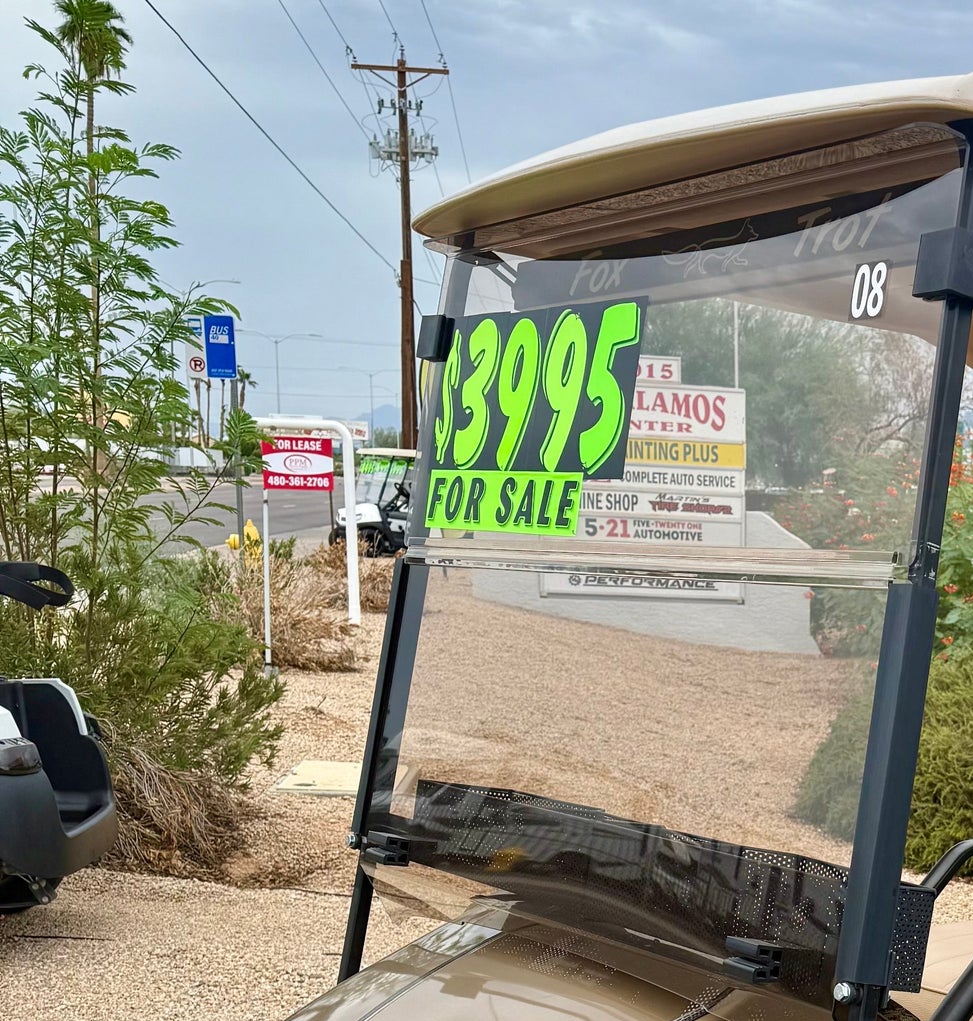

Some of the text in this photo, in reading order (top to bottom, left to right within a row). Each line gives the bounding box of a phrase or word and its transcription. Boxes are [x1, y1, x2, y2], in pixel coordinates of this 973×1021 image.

[851, 262, 888, 320] 08
[210, 325, 229, 335] BUS
[434, 302, 640, 475] $3995
[632, 390, 726, 432] LAMOS
[293, 440, 322, 451] LEASE
[626, 440, 719, 463] INTING PLUS
[268, 475, 330, 488] 480-361-2706
[621, 470, 736, 488] OMPLETE AUTO SERVICE
[428, 476, 579, 528] FOR SALE
[579, 492, 638, 511] INE SHOP
[633, 529, 703, 541] AUTOMOTIVE
[687, 522, 702, 530] ONE
[584, 575, 717, 589] PERFORMANCE
